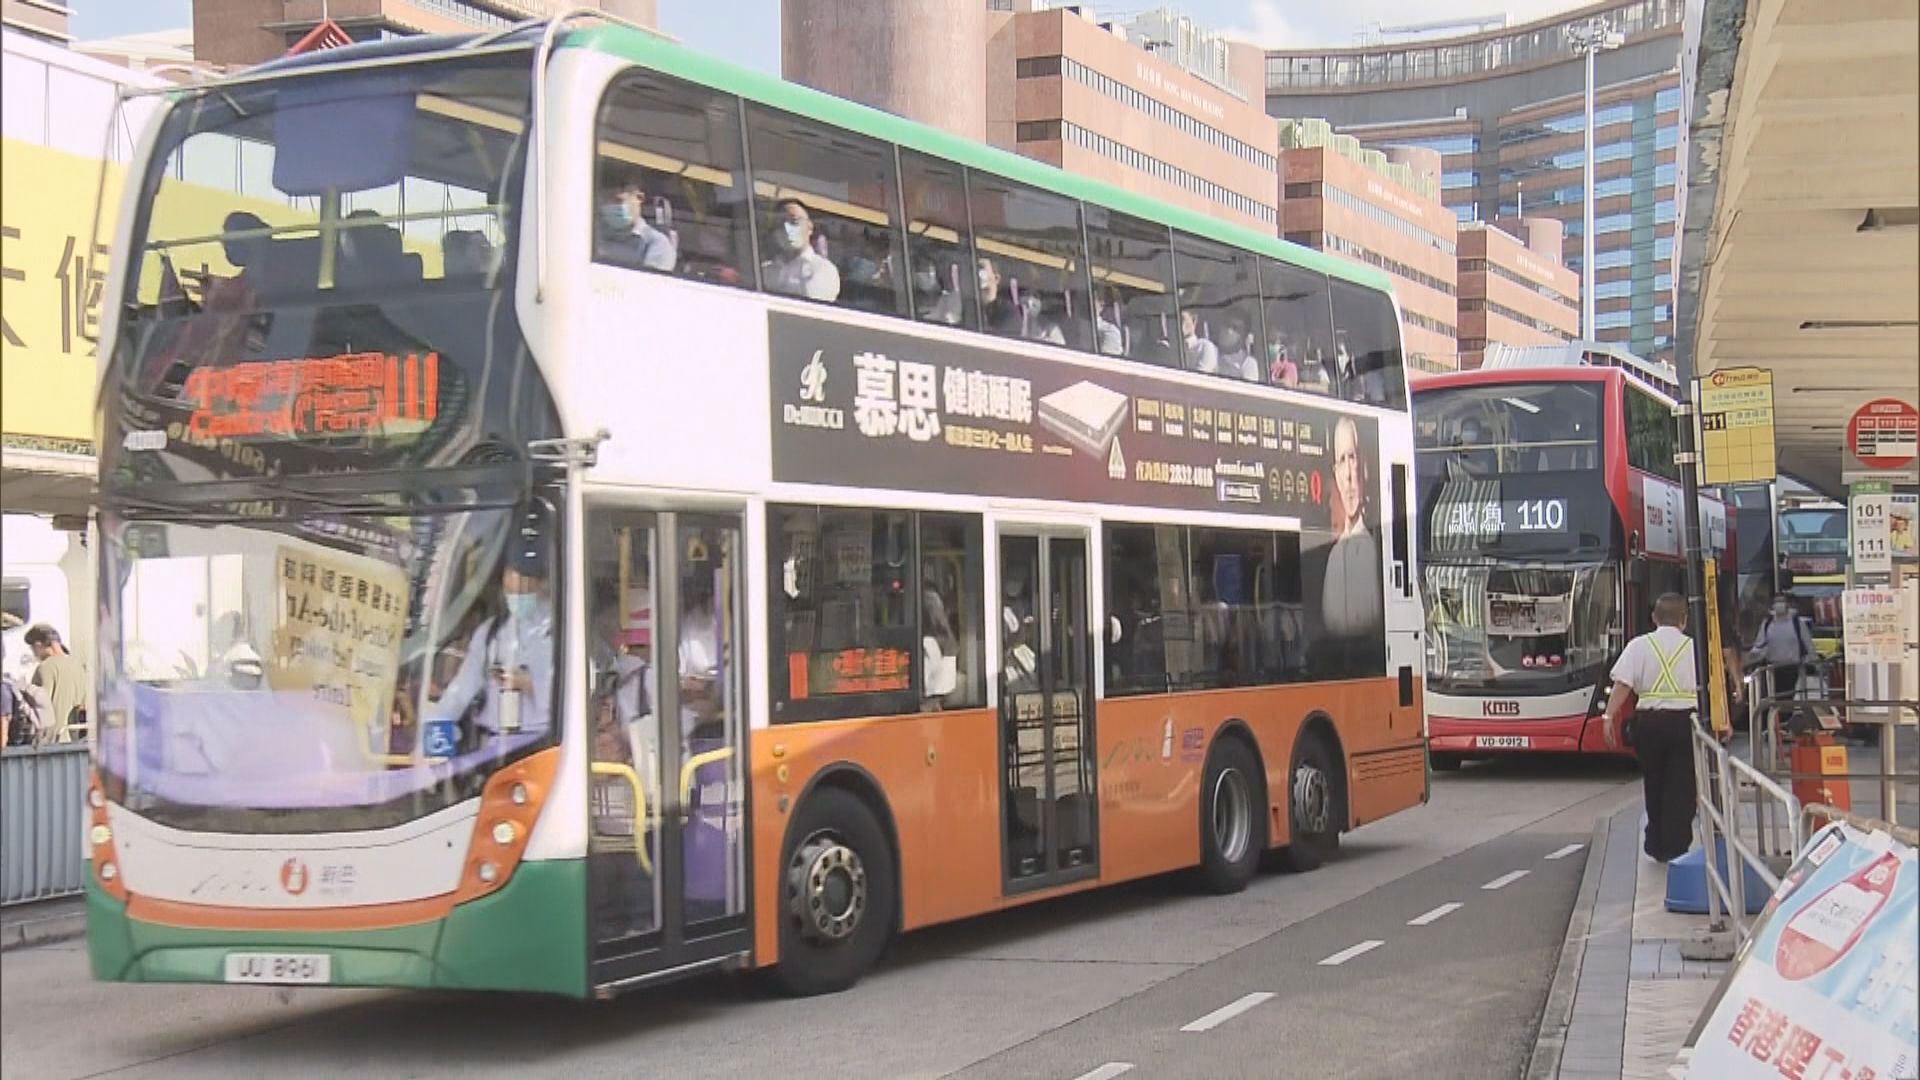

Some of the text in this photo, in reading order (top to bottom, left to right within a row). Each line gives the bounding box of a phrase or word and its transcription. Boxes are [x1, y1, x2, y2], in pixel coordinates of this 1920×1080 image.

[853, 351, 1033, 441] 慕思 健康睡眠
[1450, 500, 1502, 525] 北角
[1517, 499, 1563, 530] 110
[1856, 503, 1883, 517] 101
[1857, 538, 1884, 552] 111
[1482, 700, 1521, 716] KMB
[1481, 737, 1522, 747] VD 9912
